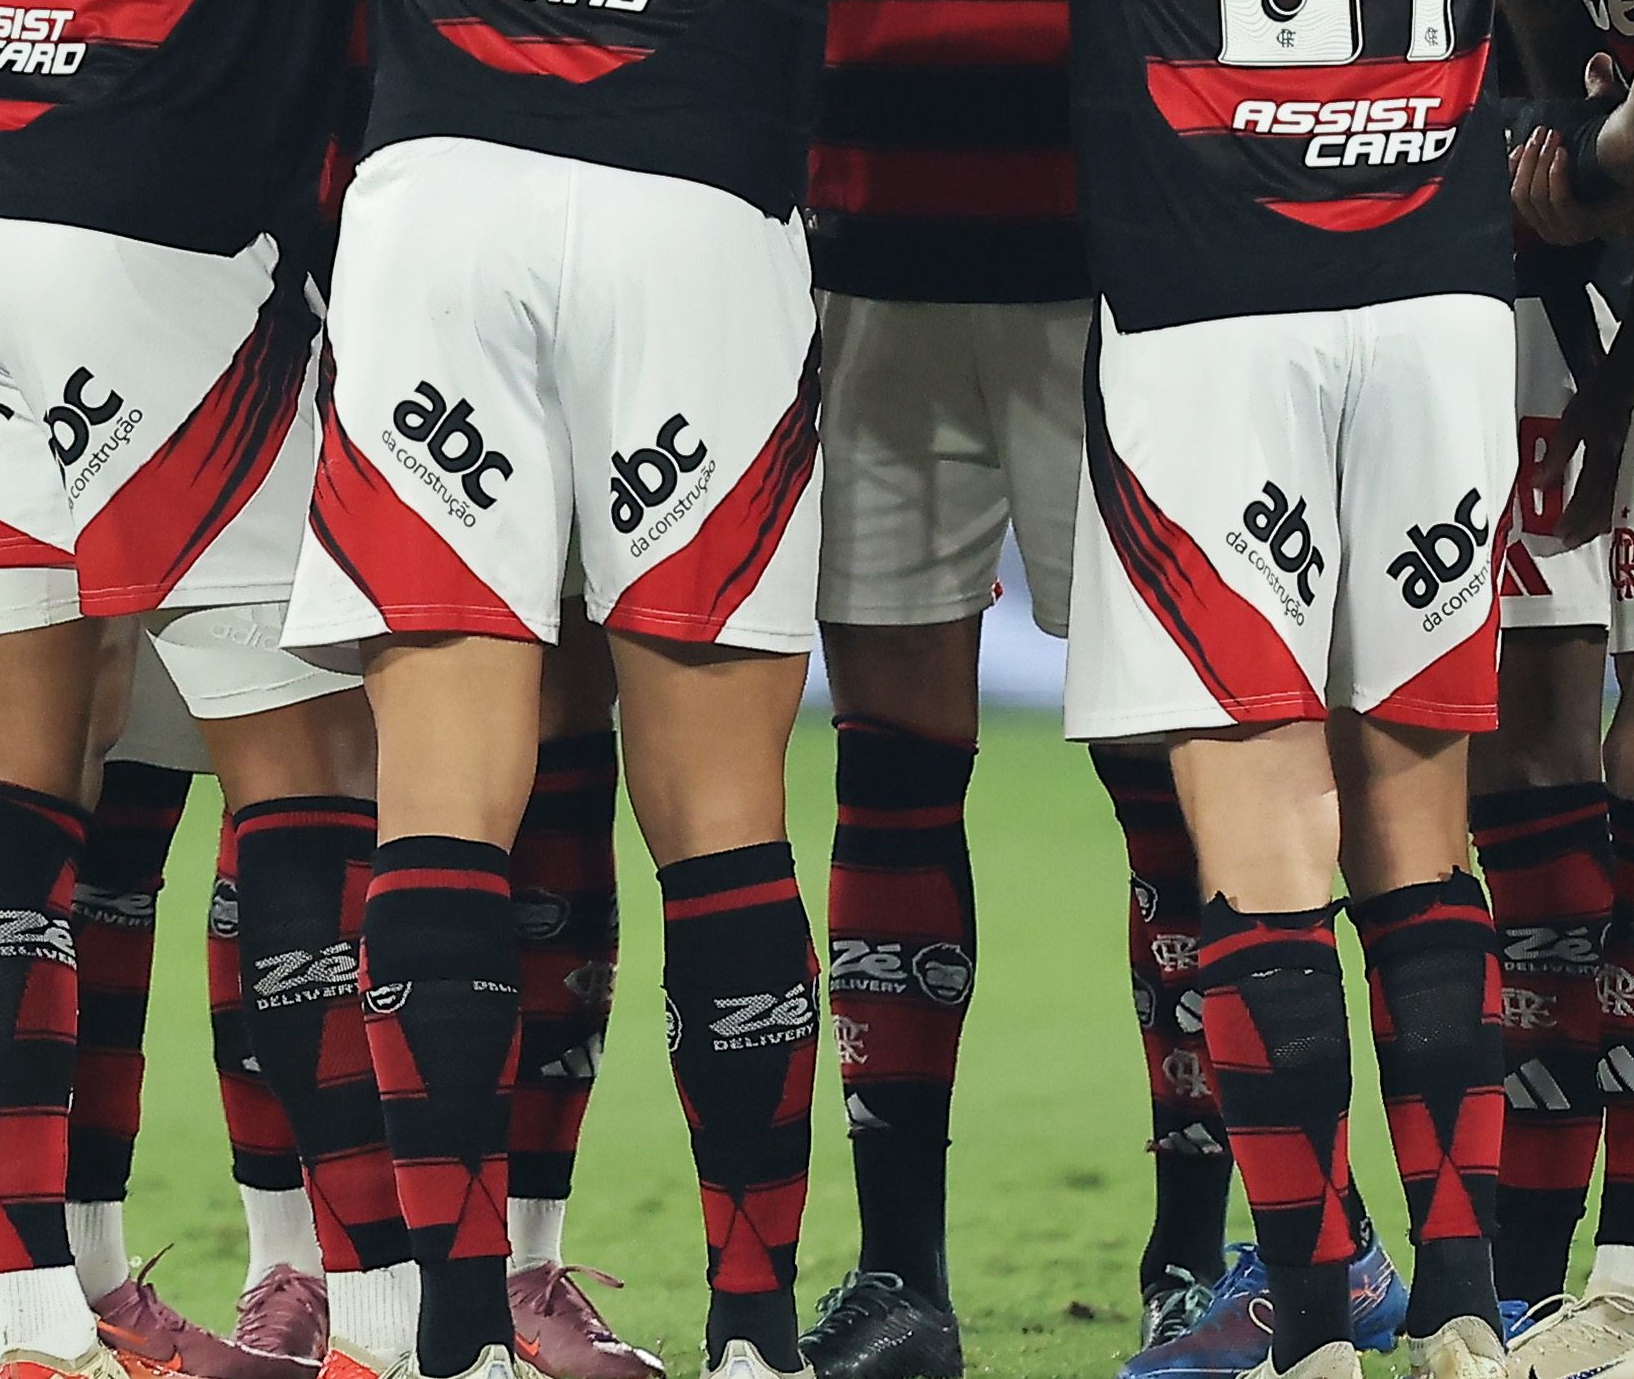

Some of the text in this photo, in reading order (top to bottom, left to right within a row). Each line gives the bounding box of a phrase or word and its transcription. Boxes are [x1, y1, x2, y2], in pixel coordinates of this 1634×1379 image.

[1233, 97, 1442, 135] ASSIST
[1304, 126, 1456, 168] CARD
[43, 365, 124, 468] bc
[69, 408, 143, 502] construção
[393, 380, 514, 510] abc
[381, 429, 477, 528] da construção
[610, 412, 709, 535] abc
[630, 460, 717, 559] da construção
[1225, 531, 1306, 627] da construção
[1243, 480, 1325, 608] abc
[1386, 487, 1490, 610] abc
[1422, 562, 1490, 633] da constr
[709, 982, 815, 1038] Zé
[712, 1022, 815, 1051] DELIVERY
